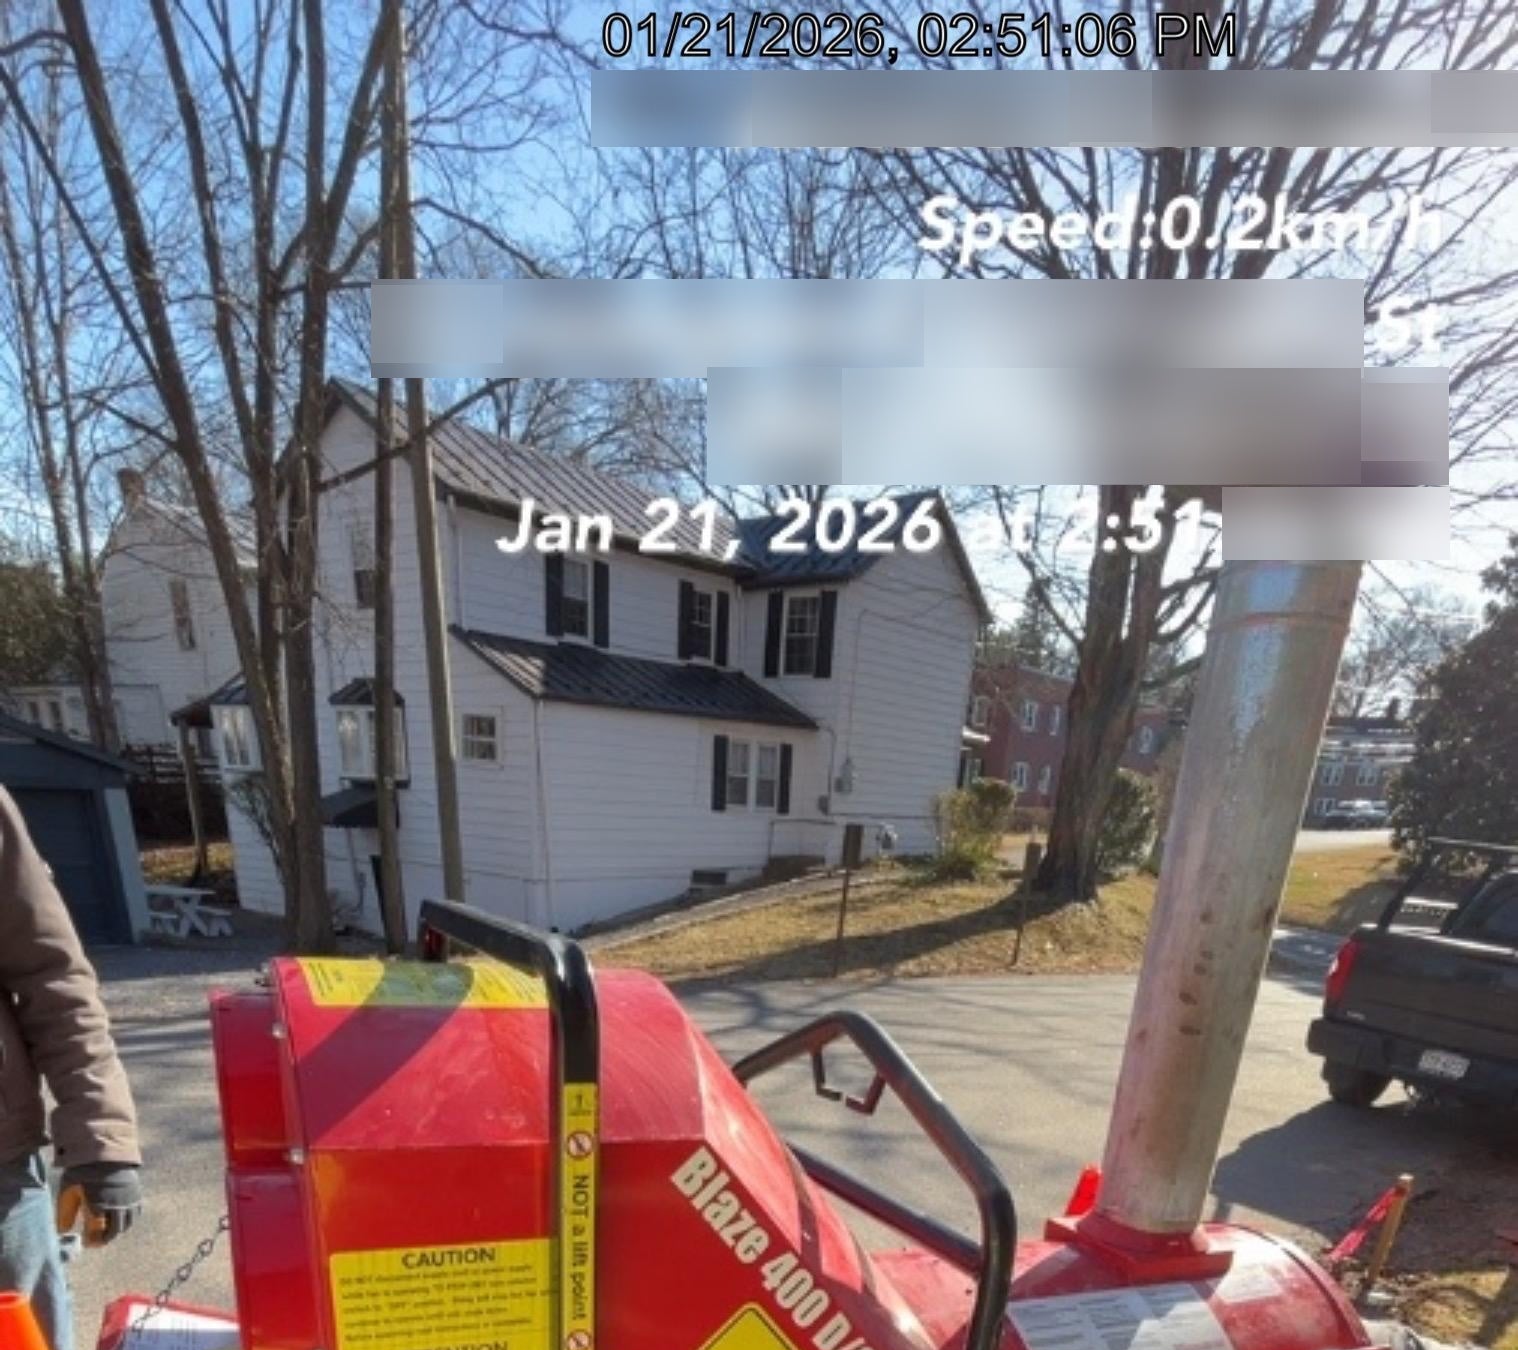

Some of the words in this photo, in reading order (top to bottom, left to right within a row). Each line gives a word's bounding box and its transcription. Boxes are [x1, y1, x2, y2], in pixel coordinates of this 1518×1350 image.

[572, 1174, 589, 1218] NOT
[575, 1224, 586, 1237] a
[670, 1145, 770, 1264] Blaze
[760, 1252, 830, 1328] 400
[401, 1247, 496, 1270] CAUTION
[572, 1241, 588, 1268] lift
[571, 1271, 588, 1321] point
